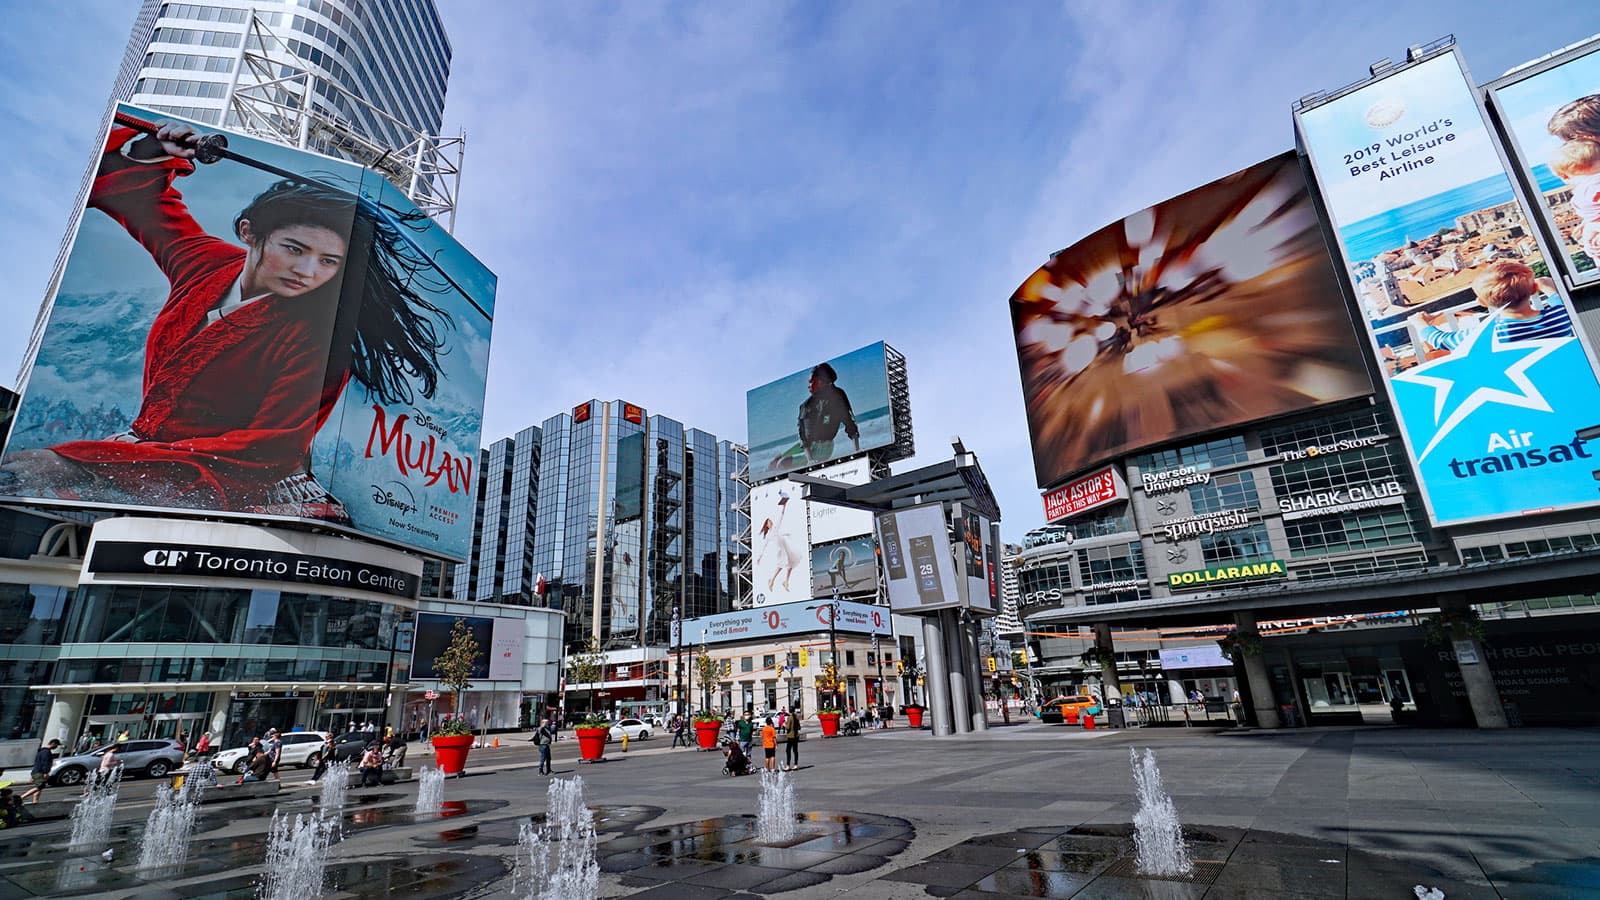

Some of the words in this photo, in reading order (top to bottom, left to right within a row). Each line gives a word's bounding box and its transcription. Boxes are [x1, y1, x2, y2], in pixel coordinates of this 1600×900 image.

[1344, 143, 1381, 165] 2019
[1386, 119, 1453, 147] World's
[1350, 156, 1387, 176] Best
[1391, 133, 1456, 161] Leisure
[1380, 155, 1435, 181] Airline
[1487, 429, 1533, 453] Air
[1448, 436, 1592, 478] transat
[1142, 466, 1196, 484] Ryerson
[1144, 473, 1210, 492] University
[1047, 490, 1069, 510] JACK
[1071, 472, 1112, 501] ASTOR'S
[1279, 490, 1342, 513] SHARK
[1348, 481, 1402, 502] CLUB
[430, 505, 459, 519] PREMIER
[1048, 507, 1065, 519] PARTY
[1065, 503, 1073, 513] IS
[1072, 497, 1087, 510] THIS
[1087, 492, 1101, 505] WAY
[389, 517, 405, 529] Now
[407, 523, 439, 541] Streaming
[429, 513, 454, 525] ACCESS
[143, 550, 188, 567] CF
[194, 551, 288, 575] Toronto
[295, 560, 352, 581] Eaton
[357, 569, 406, 591] Centre
[920, 564, 933, 575] 29
[1170, 561, 1283, 585] DOLLARAMA
[1092, 579, 1138, 590] milestones
[709, 617, 741, 629] Everything
[741, 616, 753, 625] you
[712, 628, 728, 636] need
[728, 625, 749, 634] &more
[1503, 647, 1553, 660] REAL
